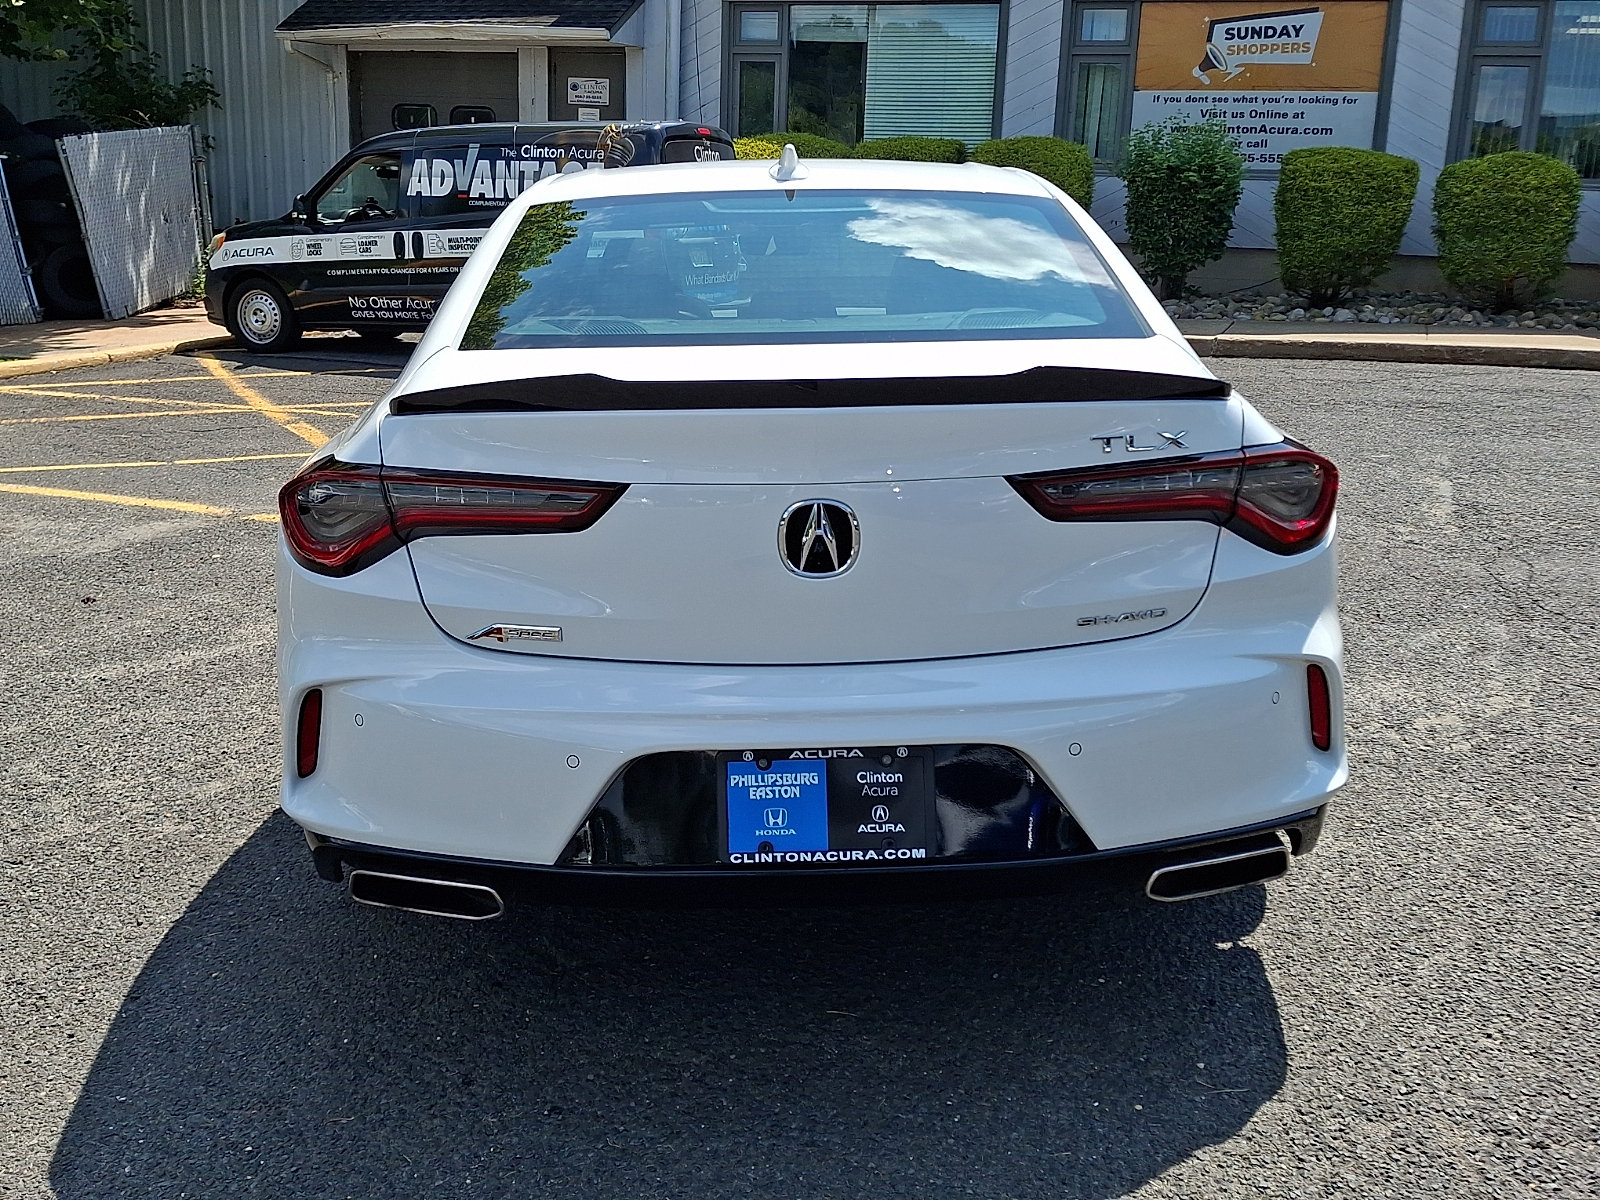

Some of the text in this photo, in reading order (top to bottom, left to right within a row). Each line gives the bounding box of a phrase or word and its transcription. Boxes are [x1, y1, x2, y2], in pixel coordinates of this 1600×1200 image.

[1224, 24, 1305, 41] SUNDAY
[1226, 42, 1311, 56] SHOPPERS
[580, 83, 607, 91] CLINTON
[1152, 94, 1359, 106] If you dont see what you're looking for
[1200, 109, 1306, 119] Visit us Online at
[1246, 139, 1268, 148] call
[500, 145, 605, 159] The Clinton Acura
[230, 247, 275, 259] ACURA
[327, 268, 381, 276] COMPLIMENTARY
[348, 296, 367, 308] No
[369, 296, 402, 309] Other
[351, 310, 375, 318] GIVES
[375, 311, 394, 319] YOU
[1089, 430, 1190, 453] TLX
[788, 748, 865, 760] ACURA
[730, 772, 820, 787] PHILLIPSBURG
[856, 771, 904, 783] Clinton
[749, 786, 801, 800] EASTON
[861, 784, 899, 797] Acura
[755, 828, 797, 836] HONDA
[857, 823, 906, 833] ACURA
[729, 848, 926, 864] CLINTONACURA.COM
